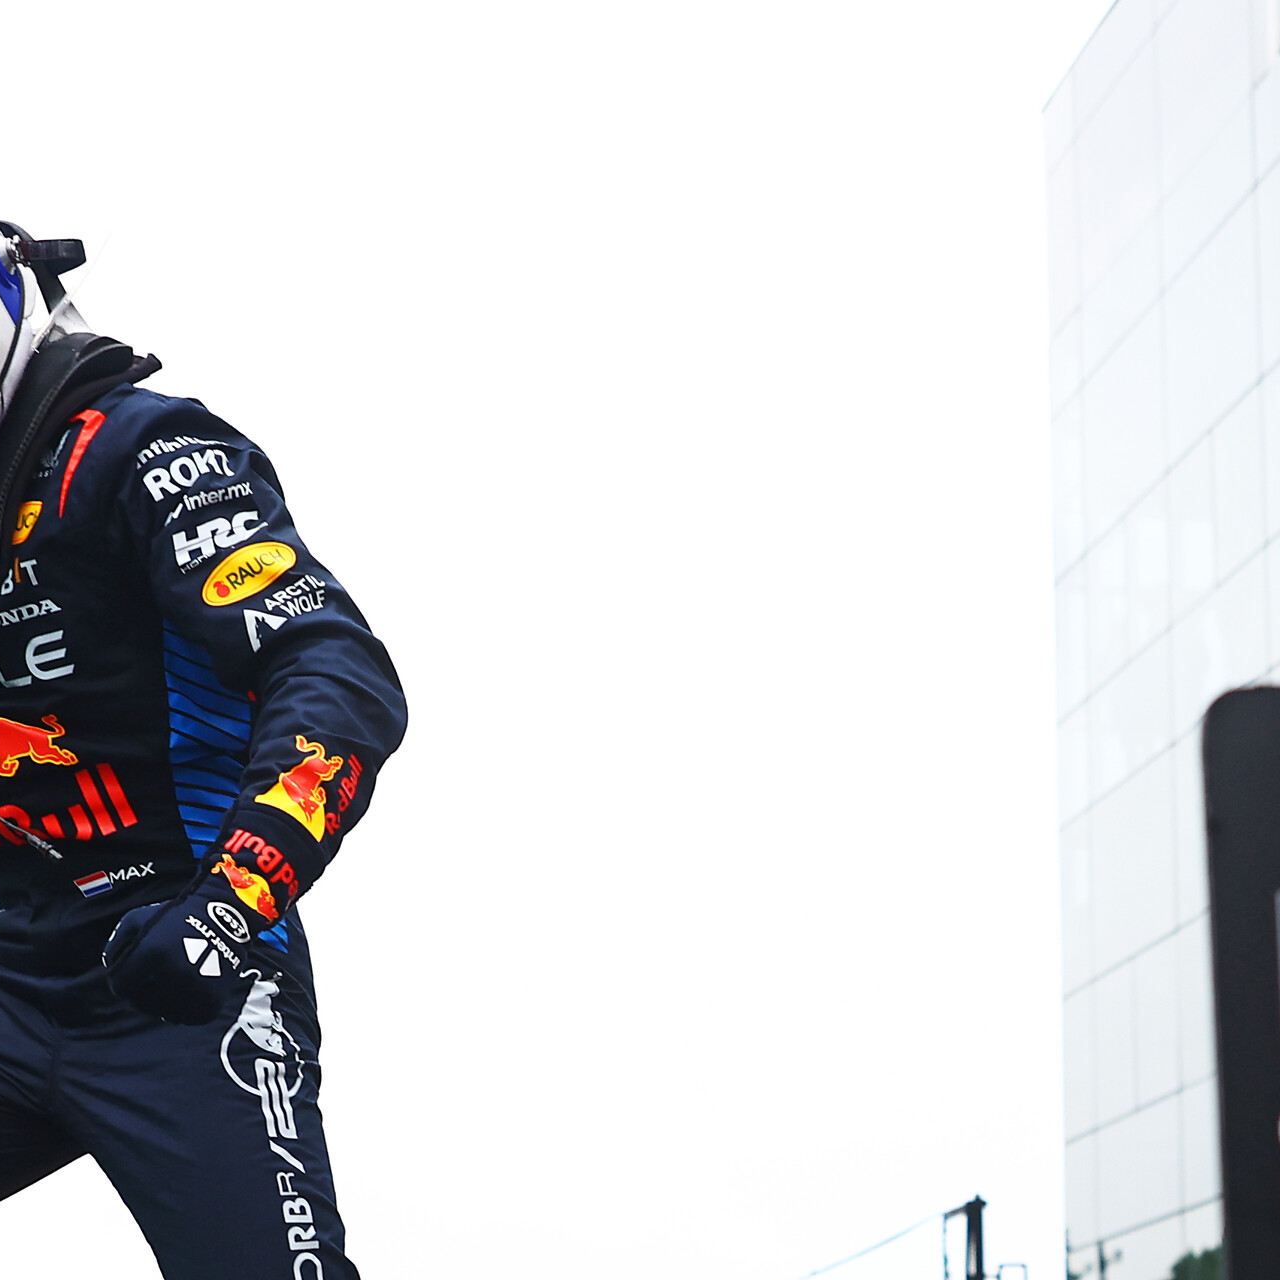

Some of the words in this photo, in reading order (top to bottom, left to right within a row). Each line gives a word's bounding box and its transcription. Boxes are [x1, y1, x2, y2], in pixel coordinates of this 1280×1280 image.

[183, 481, 254, 511] inter.mx
[172, 510, 269, 567] HRC
[226, 549, 288, 590] RAUCH
[279, 590, 326, 617] WOLF
[109, 861, 155, 884] MAX
[224, 829, 284, 875] Bull
[185, 914, 241, 970] inter.mx
